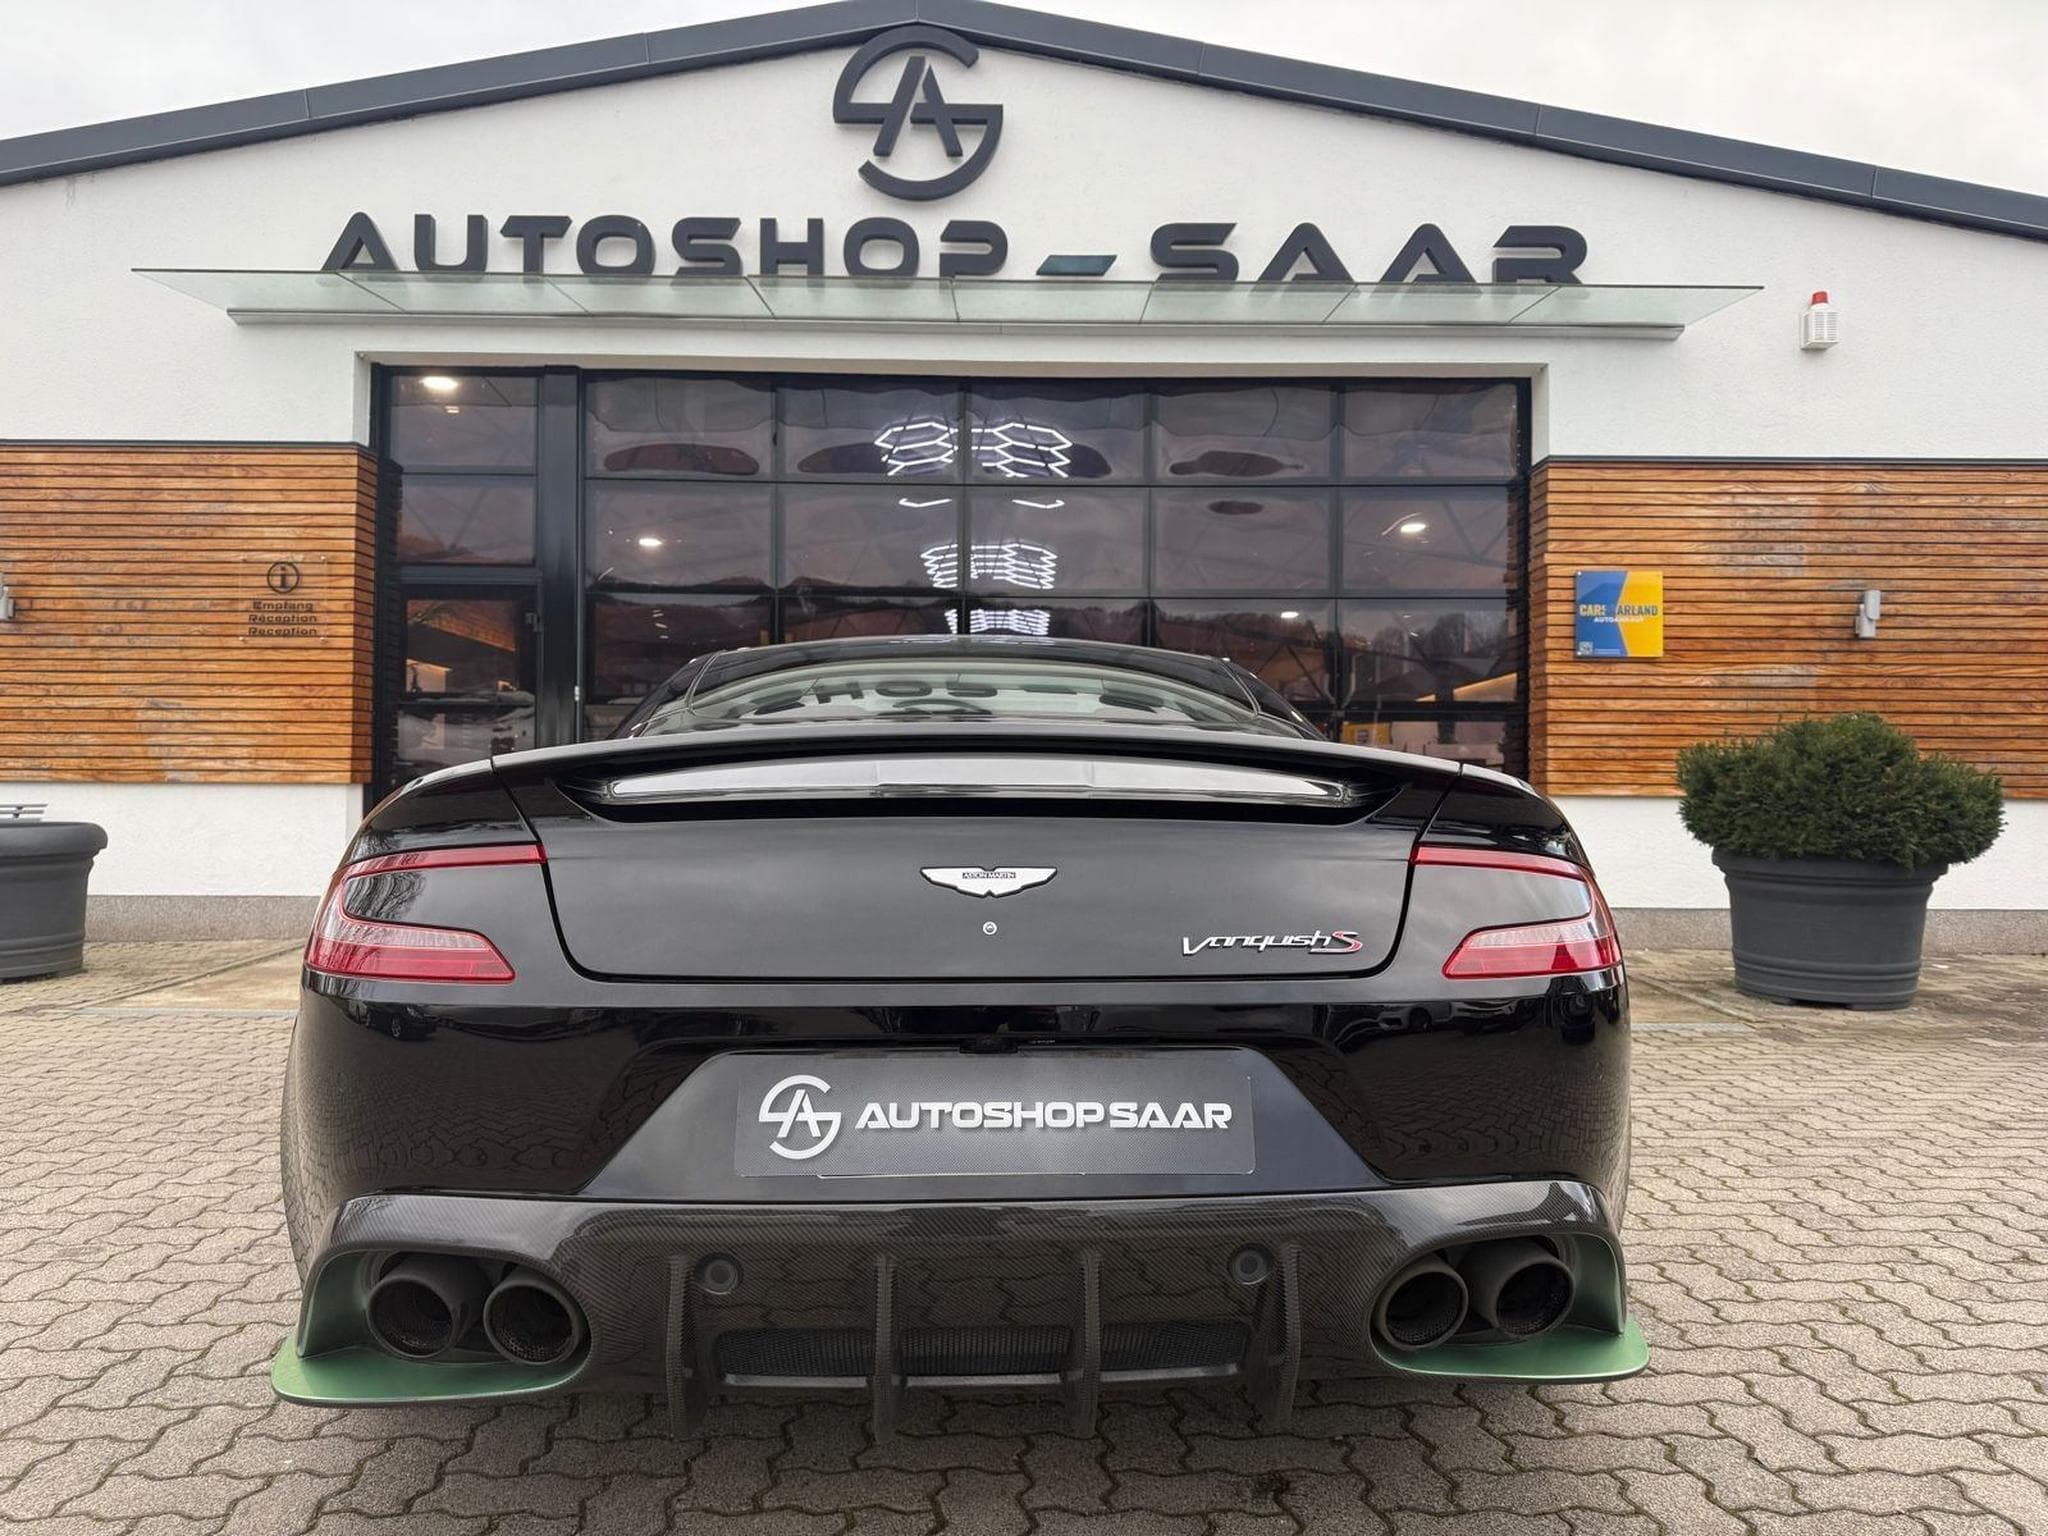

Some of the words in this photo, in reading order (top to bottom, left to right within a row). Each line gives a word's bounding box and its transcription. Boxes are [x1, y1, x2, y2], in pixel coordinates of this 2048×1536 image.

[320, 210, 1009, 281] AUTOSHOP
[1150, 222, 1588, 287] SAAR
[248, 626, 317, 638] Reception
[1182, 930, 1331, 955] Vanquish
[854, 1101, 1105, 1130] AUTOSHOP
[1108, 1102, 1233, 1130] SAAR
